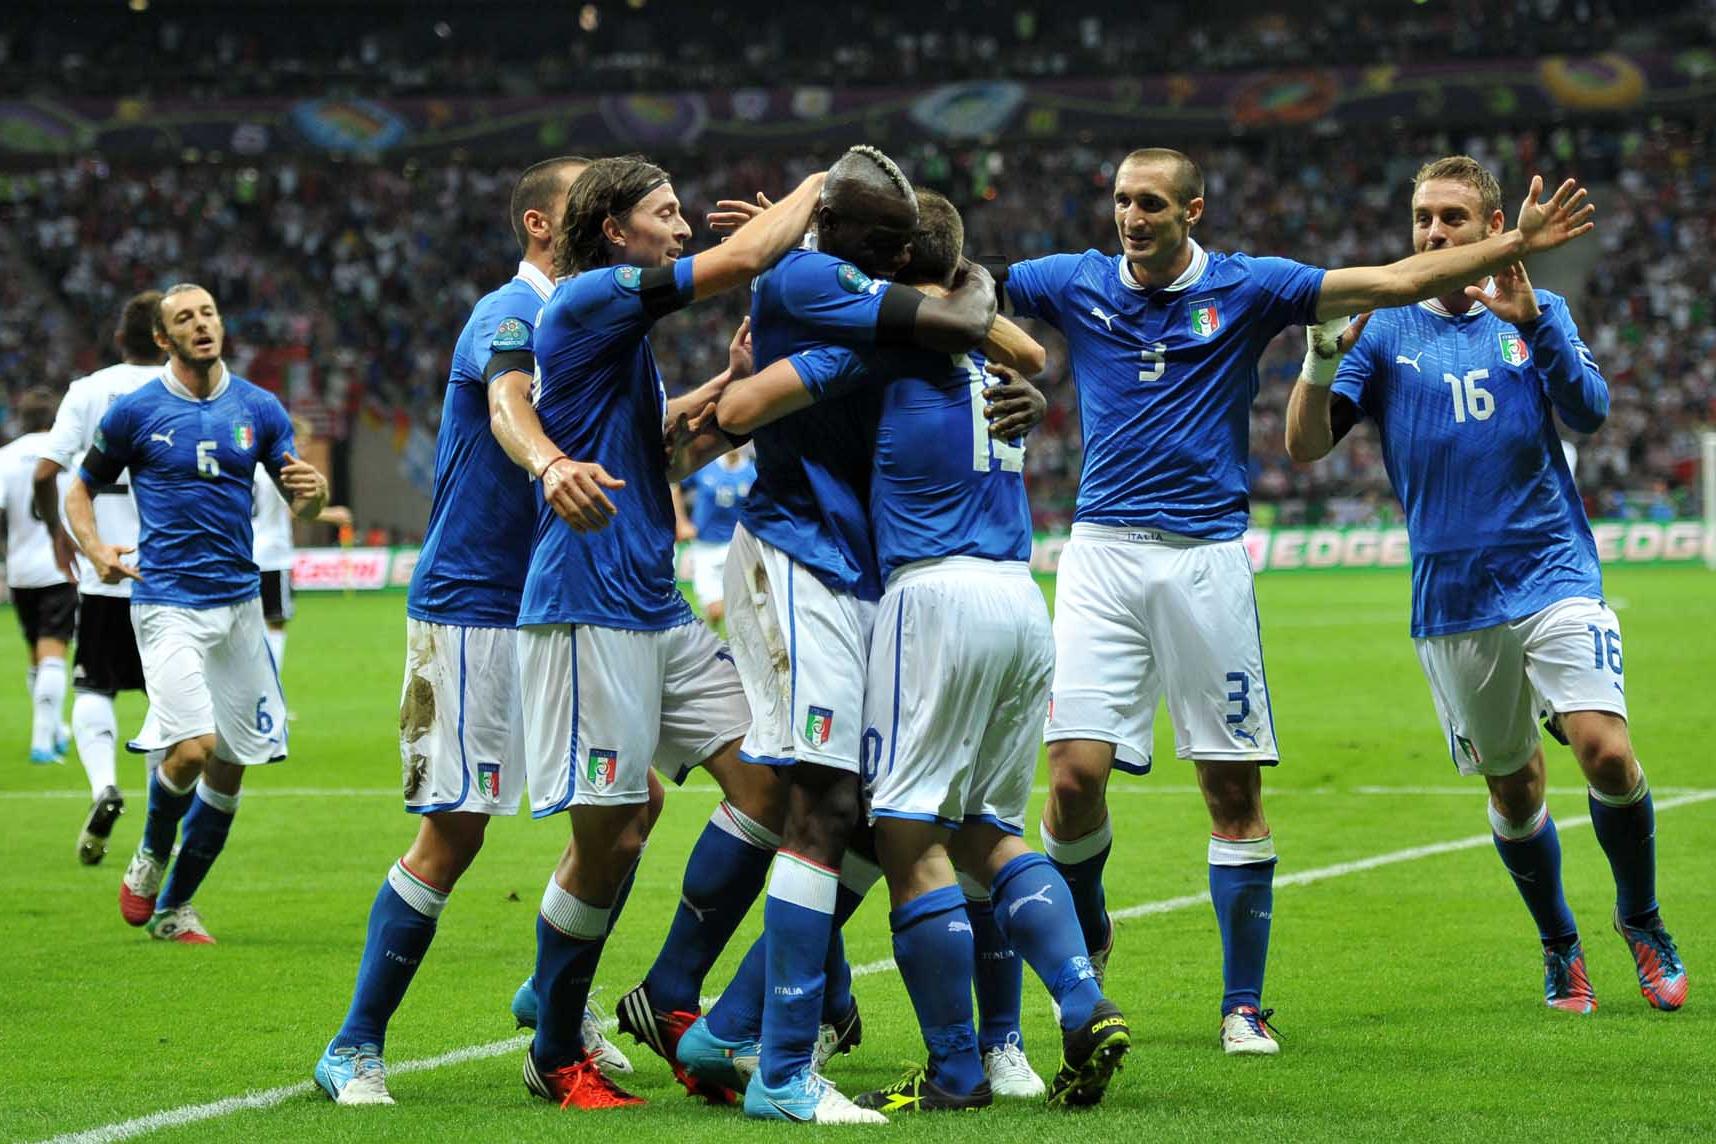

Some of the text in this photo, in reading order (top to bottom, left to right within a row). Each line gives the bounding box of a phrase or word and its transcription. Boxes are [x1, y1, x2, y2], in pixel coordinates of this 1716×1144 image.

[1139, 342, 1168, 382] 3
[1443, 368, 1496, 423] 16
[196, 440, 221, 478] 6
[1127, 533, 1163, 541] ITALIA
[1271, 527, 1413, 569] EDGE
[1594, 522, 1712, 562] EDG
[1587, 624, 1624, 676] 16
[256, 696, 274, 734] 6
[1226, 671, 1250, 725] 3
[862, 727, 884, 784] 0
[774, 985, 804, 996] ITALIA
